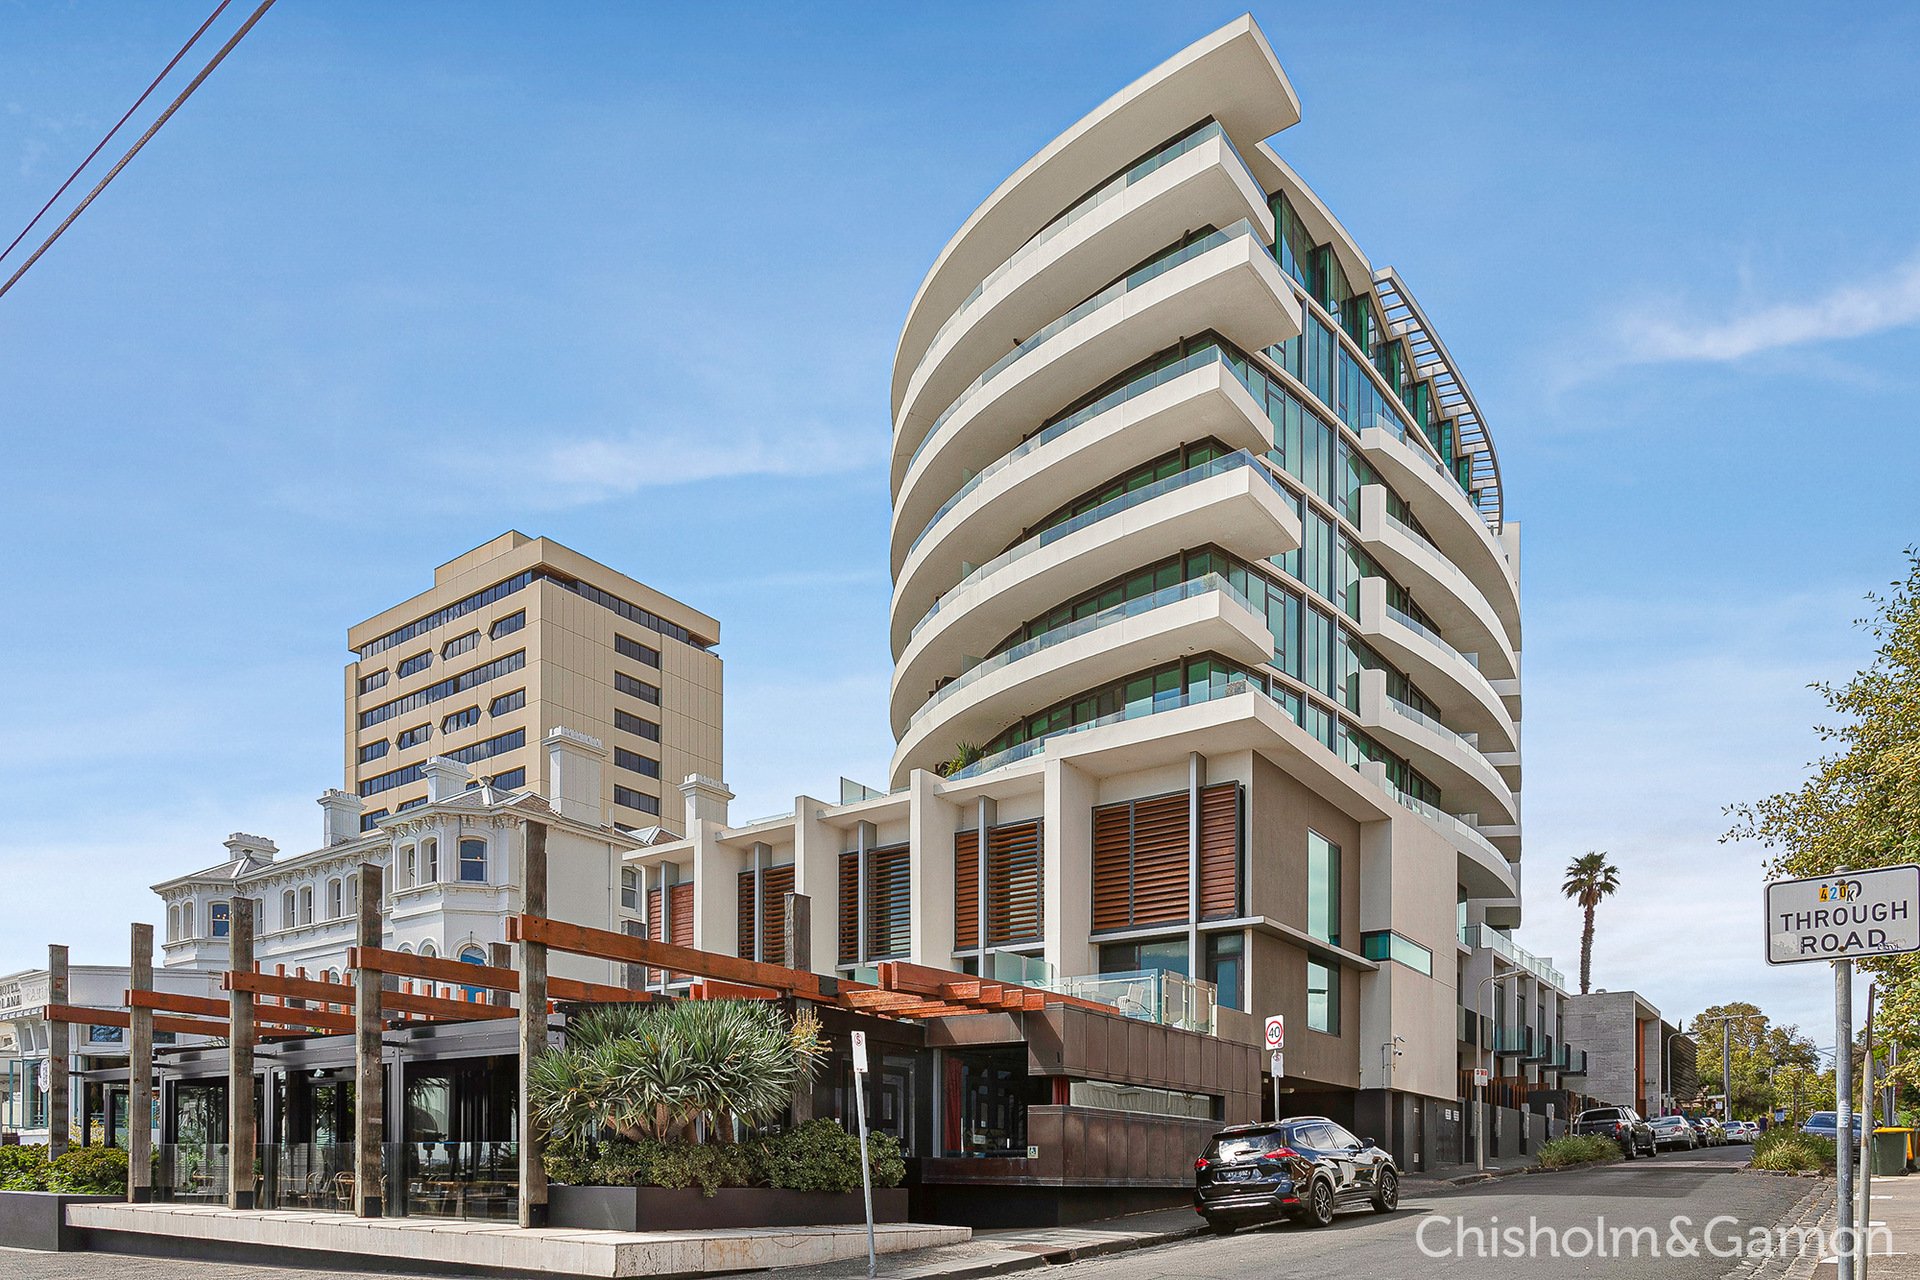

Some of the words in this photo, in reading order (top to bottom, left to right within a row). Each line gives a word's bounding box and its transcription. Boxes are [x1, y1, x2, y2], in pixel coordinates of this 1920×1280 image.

[1780, 900, 1908, 932] THROUGH
[1800, 929, 1886, 955] ROAD
[1268, 1026, 1281, 1038] 40
